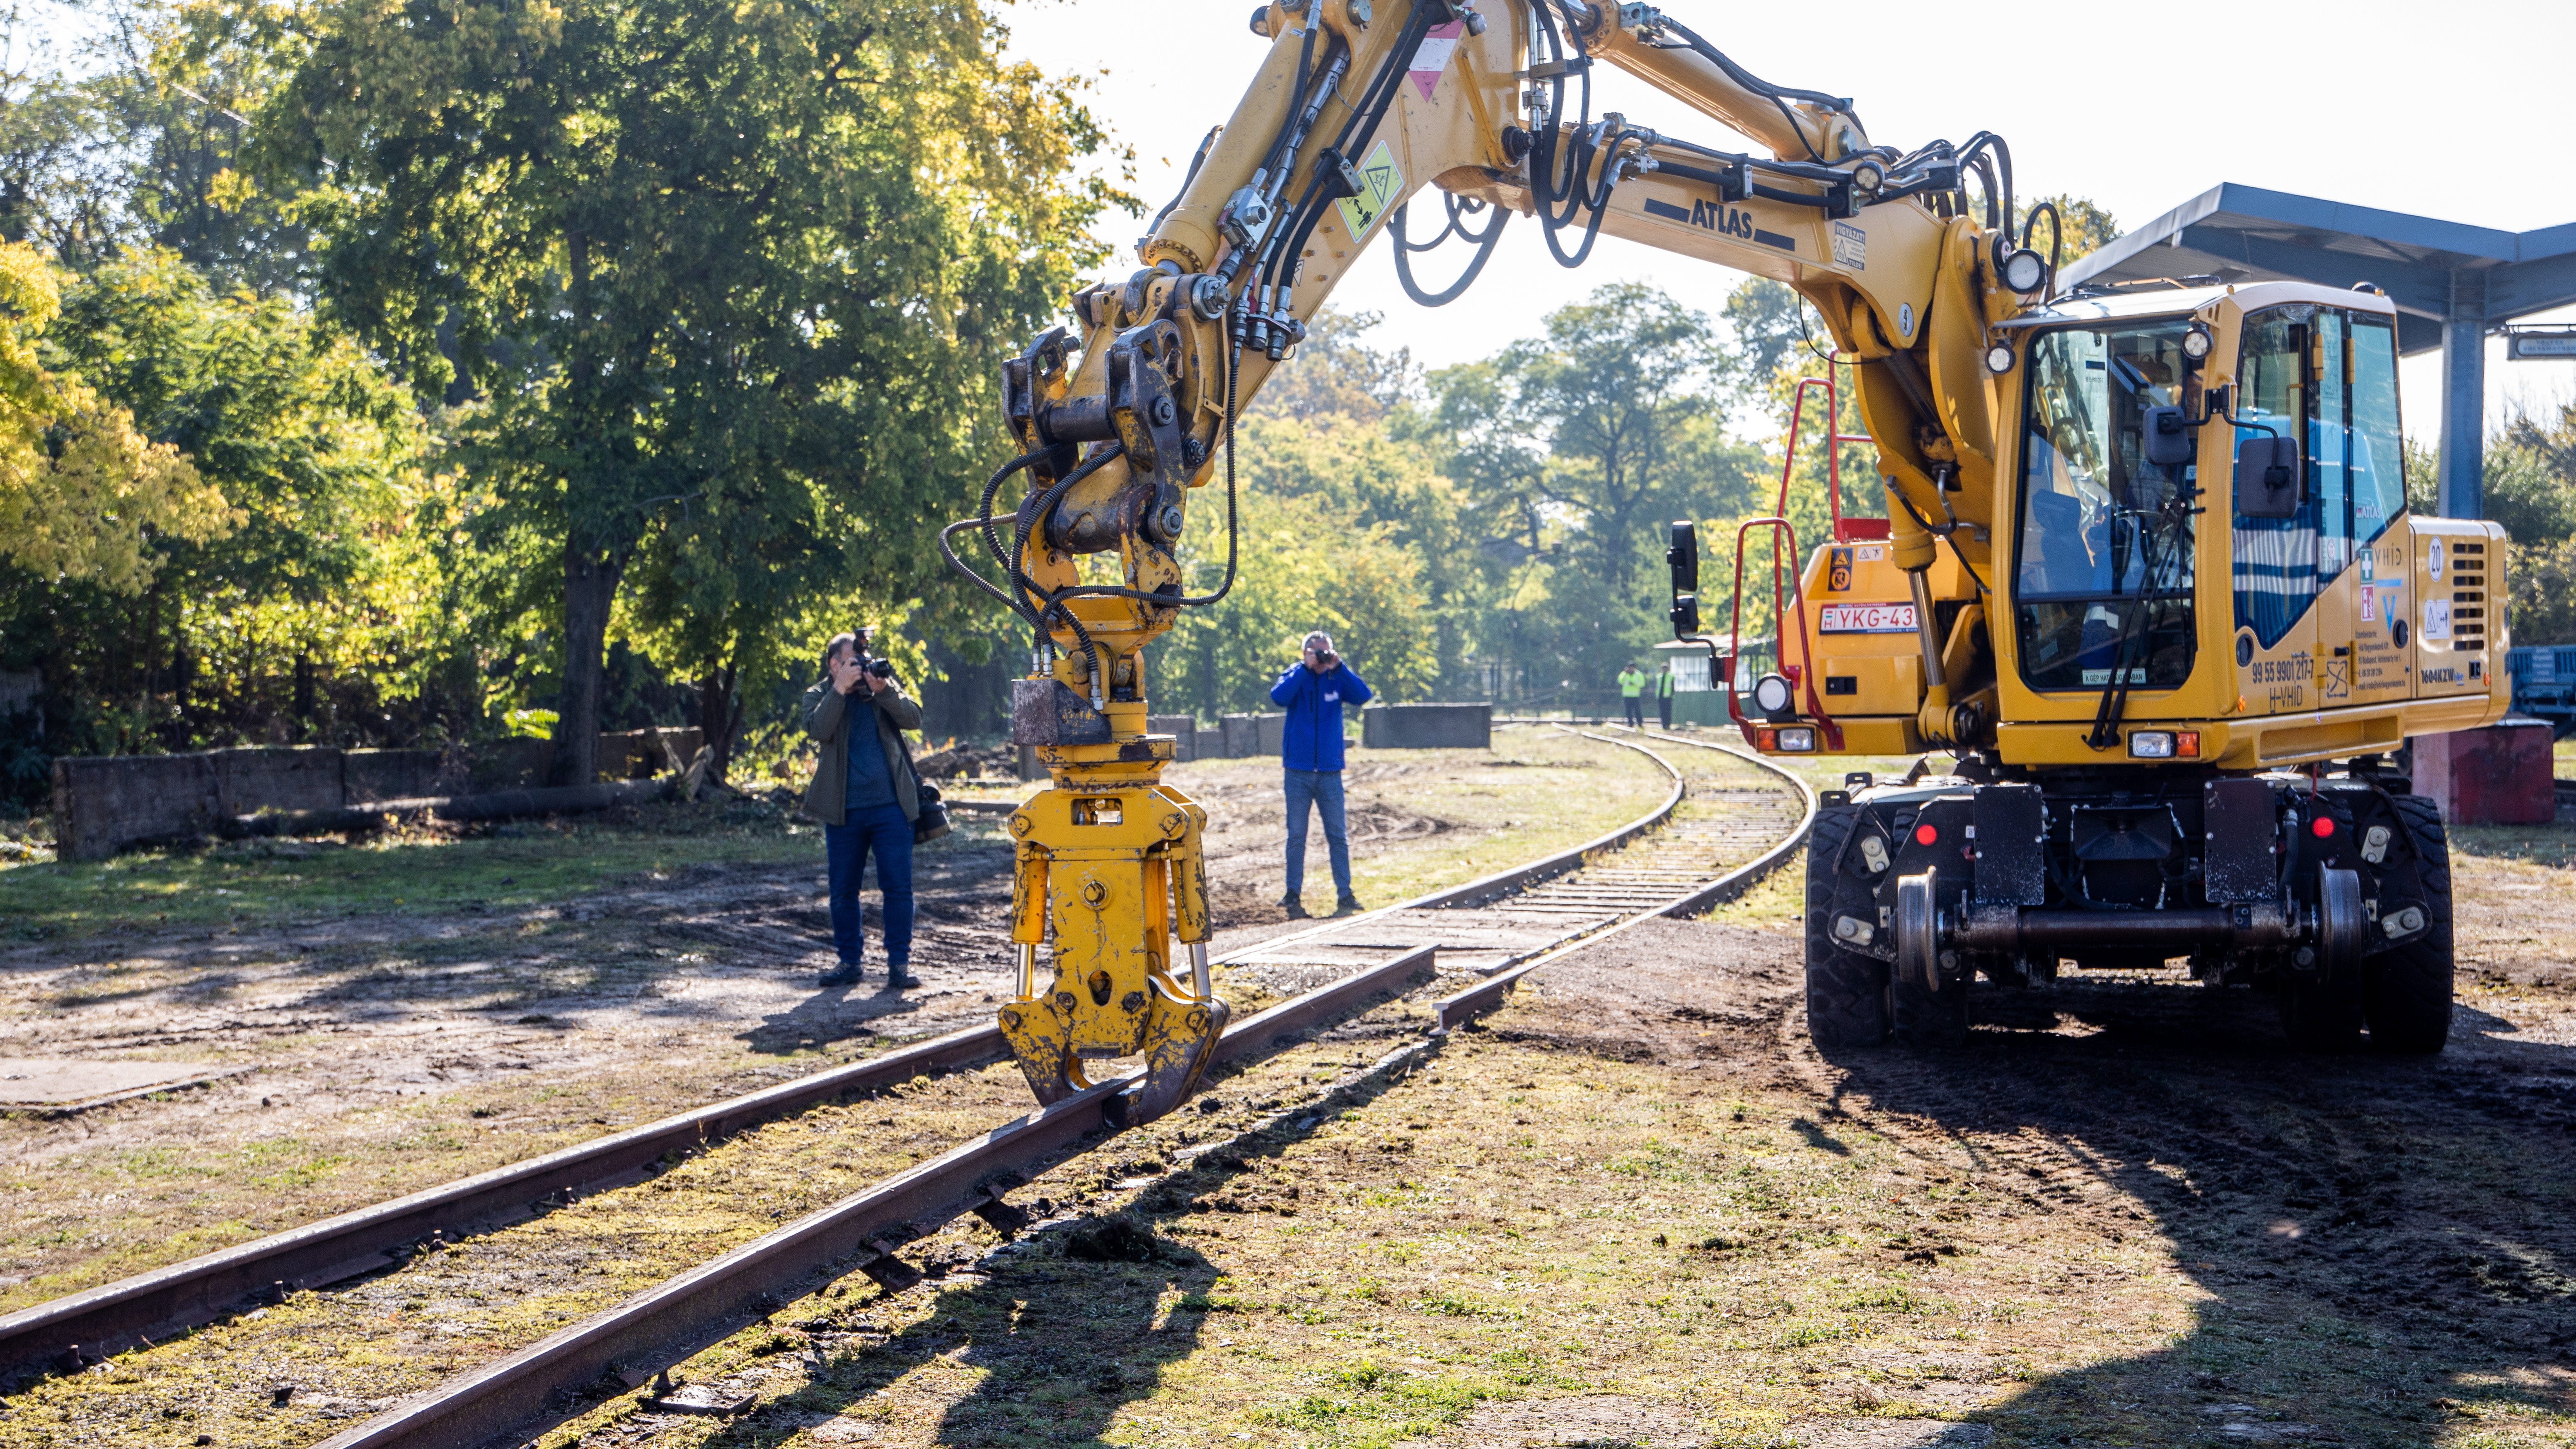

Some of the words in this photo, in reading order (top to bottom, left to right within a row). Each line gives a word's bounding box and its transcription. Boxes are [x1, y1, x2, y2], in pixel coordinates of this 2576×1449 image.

[1691, 198, 1752, 239] ATLAS
[1836, 224, 1865, 244] VIGYÁZAT!
[2362, 506, 2381, 518] ATLAS
[2431, 545, 2440, 572] 20
[1824, 620, 1832, 628] H
[1840, 608, 1918, 627] YKG-43
[2252, 662, 2262, 683] 99
[2265, 661, 2274, 682] 55
[2276, 660, 2294, 682] 9901
[2296, 659, 2314, 680] 217-7
[2421, 668, 2454, 684] 1604KZW
[2270, 680, 2302, 709] H-VHÍD
